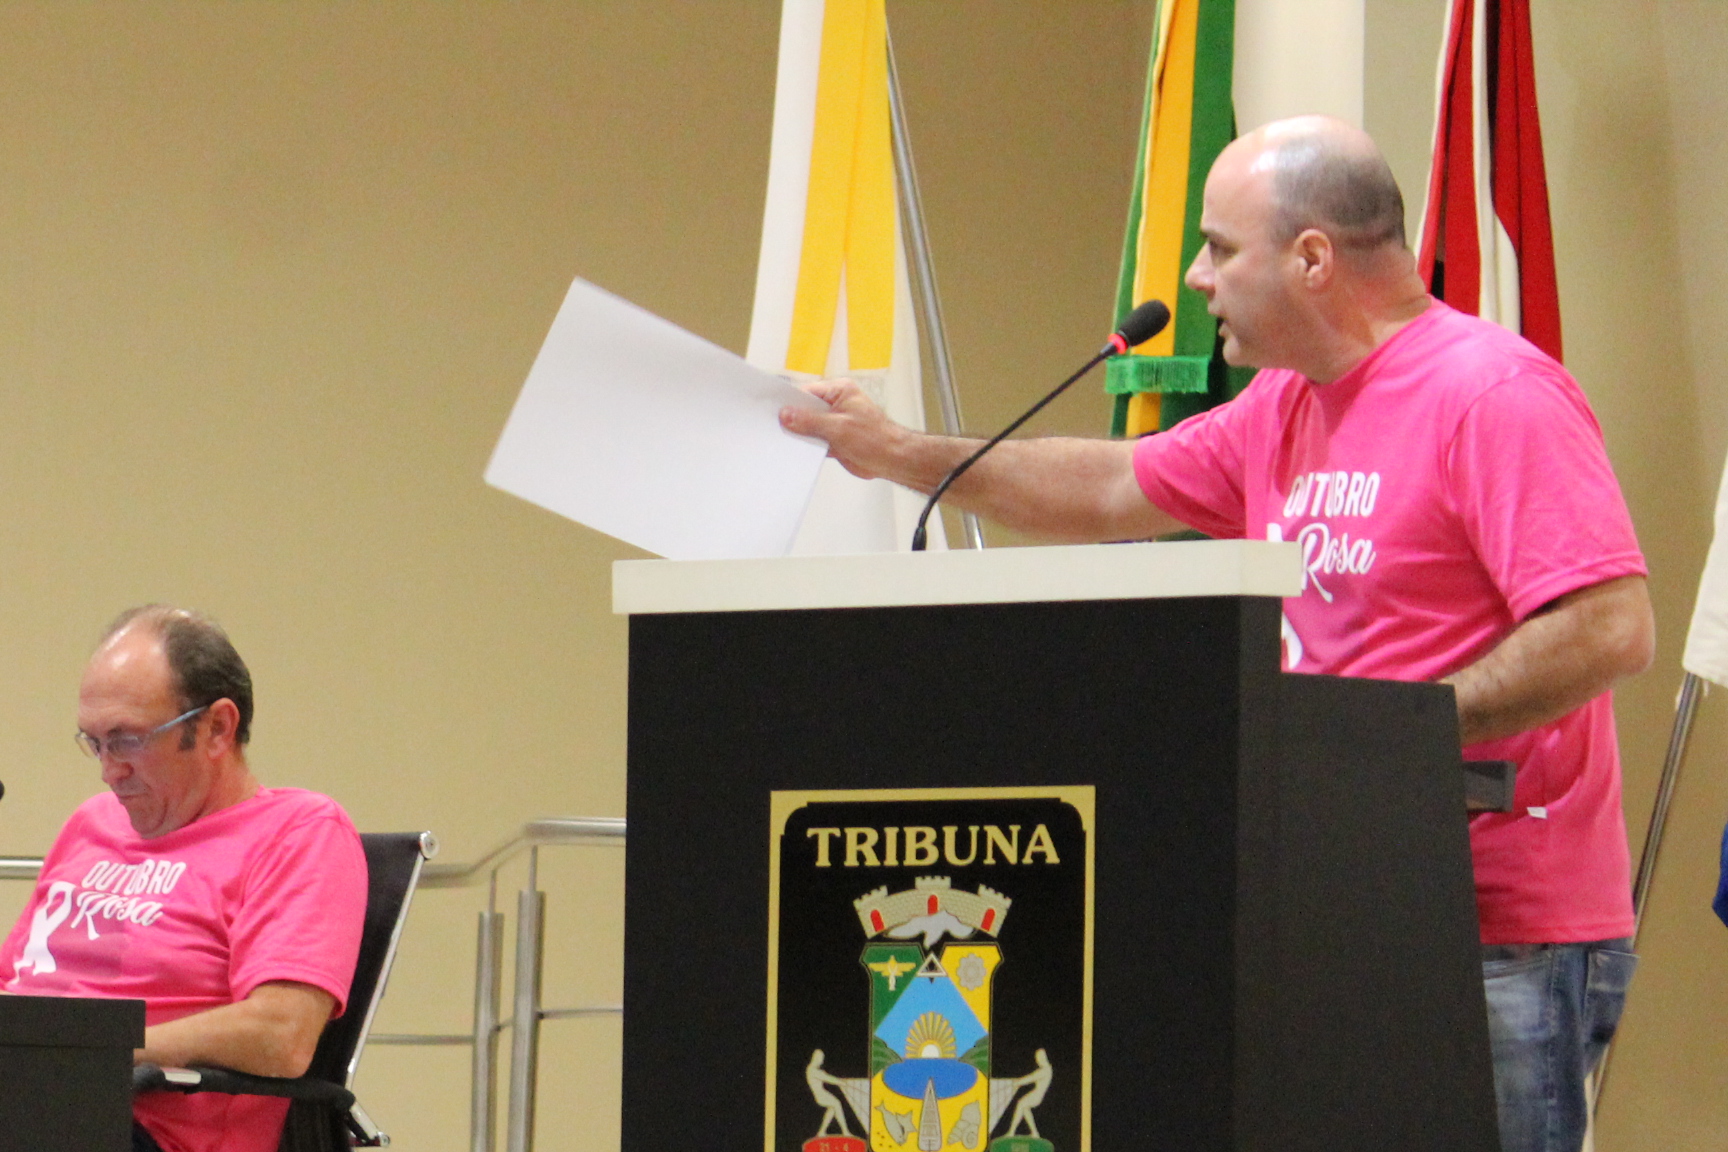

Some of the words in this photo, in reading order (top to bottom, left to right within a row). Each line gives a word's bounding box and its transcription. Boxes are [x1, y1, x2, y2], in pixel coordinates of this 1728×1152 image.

[1297, 522, 1377, 603] Rosa
[806, 824, 1061, 868] TRIBUNA
[81, 859, 187, 895] OUTUBRO
[70, 891, 164, 941] Rosa
